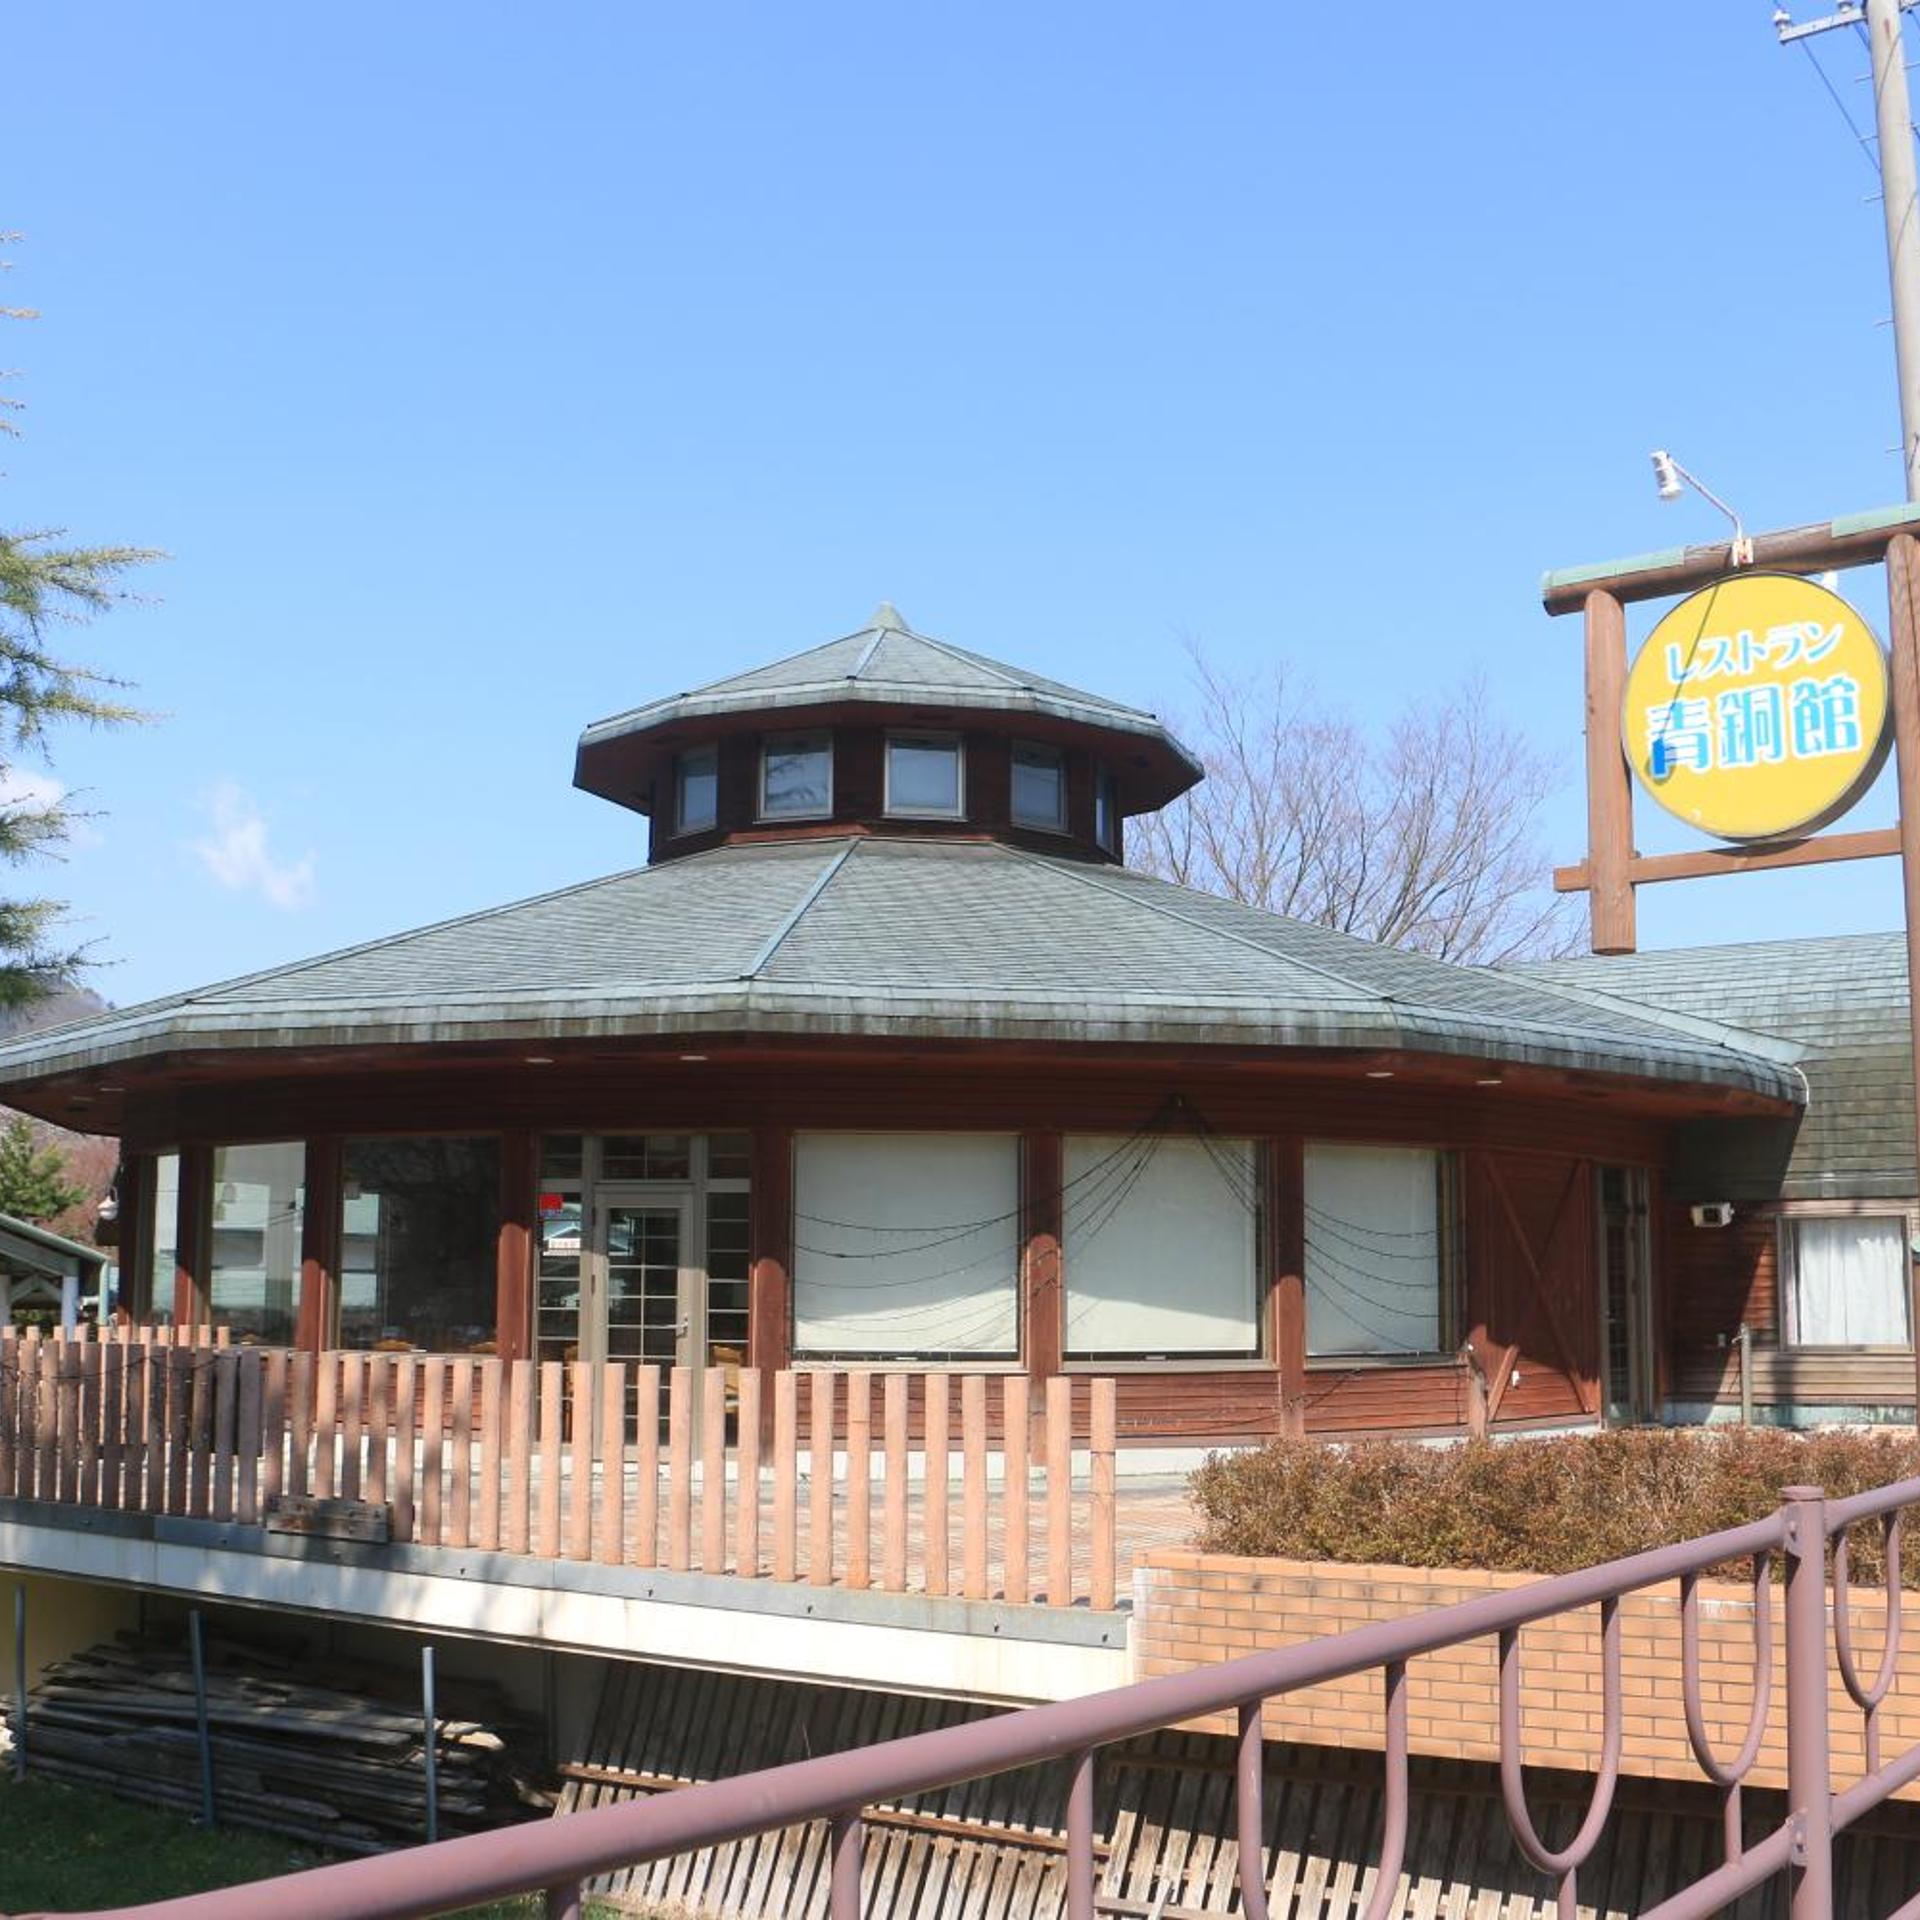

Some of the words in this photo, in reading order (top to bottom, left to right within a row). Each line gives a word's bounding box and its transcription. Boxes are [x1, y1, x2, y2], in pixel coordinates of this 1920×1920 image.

[1667, 622, 1844, 683] レストラン
[1646, 674, 1862, 778] 青銅館
